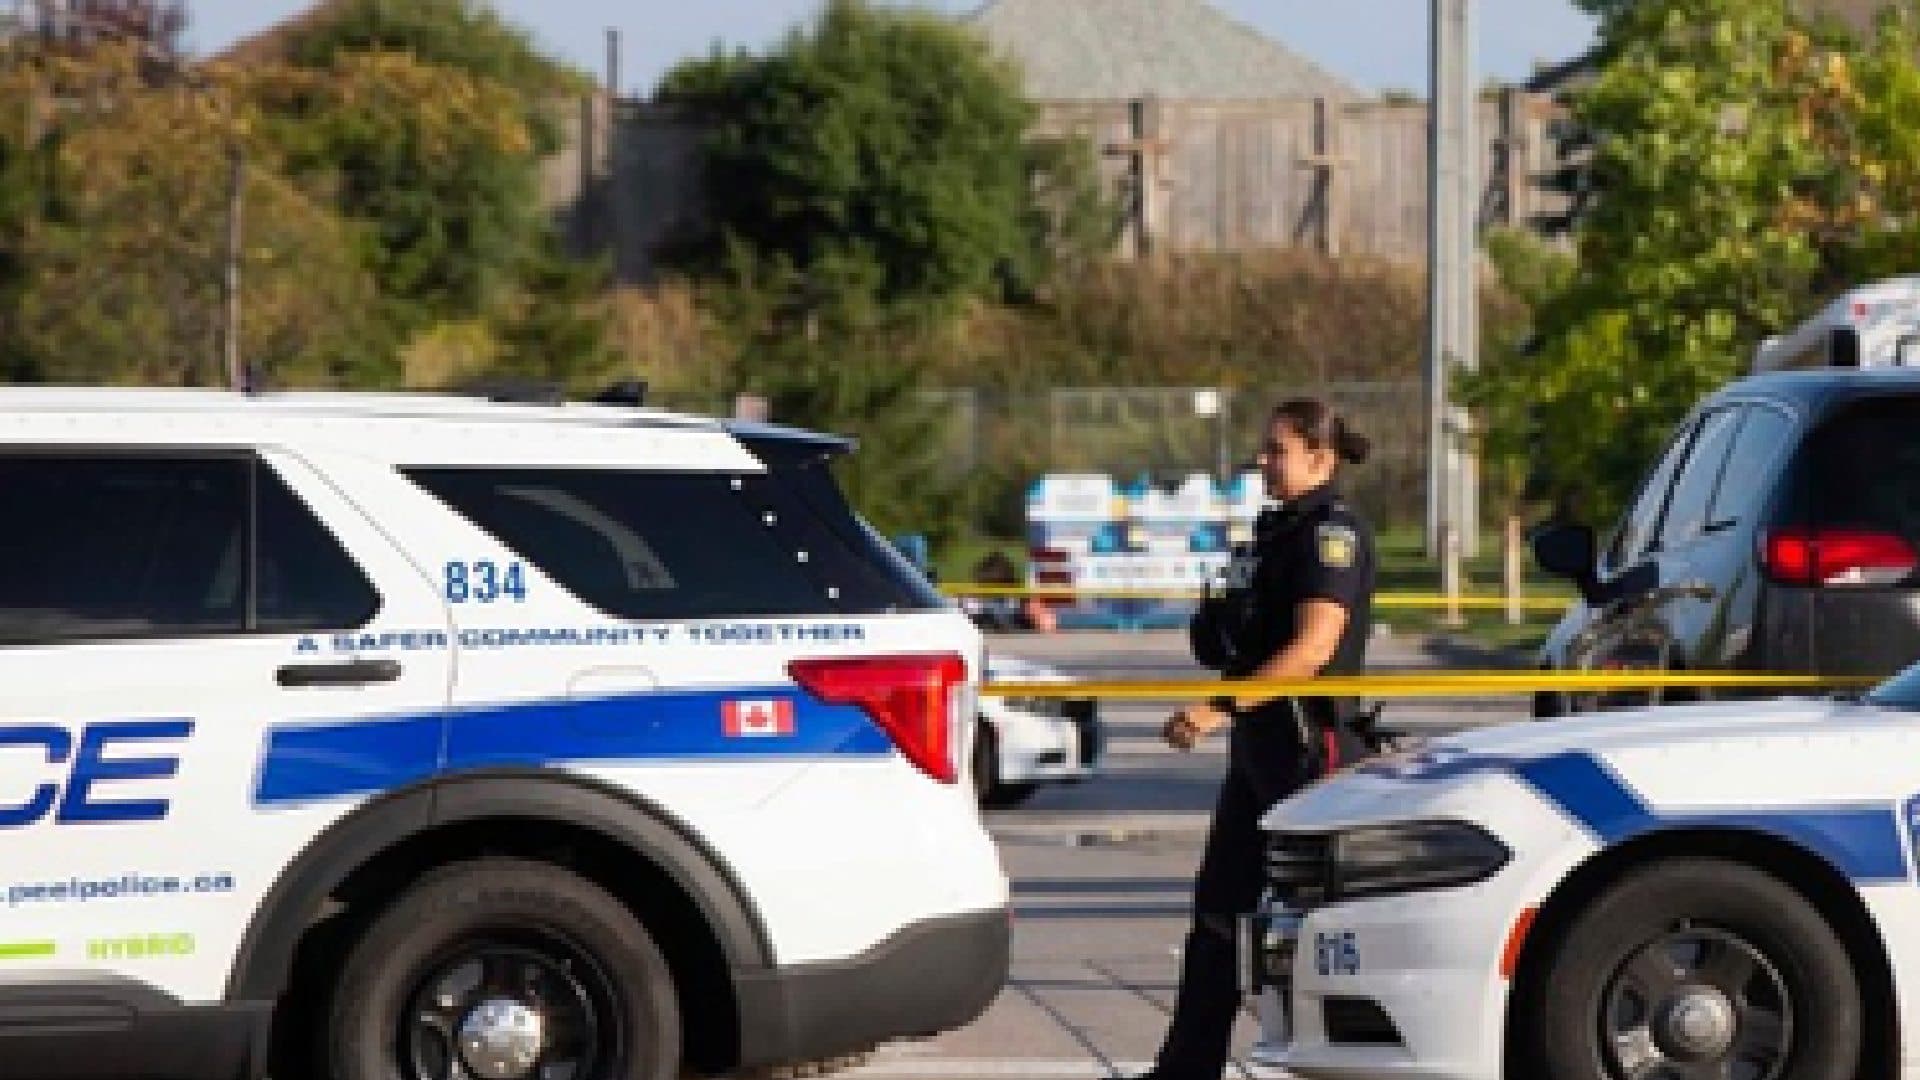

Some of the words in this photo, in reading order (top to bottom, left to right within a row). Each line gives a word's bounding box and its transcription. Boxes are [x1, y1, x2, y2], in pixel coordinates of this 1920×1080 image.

[444, 561, 525, 602] 834
[294, 632, 320, 654] A
[333, 629, 448, 651] SAFER
[459, 627, 670, 648] COMMUNITY
[686, 623, 866, 642] TOGETHER
[87, 933, 196, 959] HYBRID
